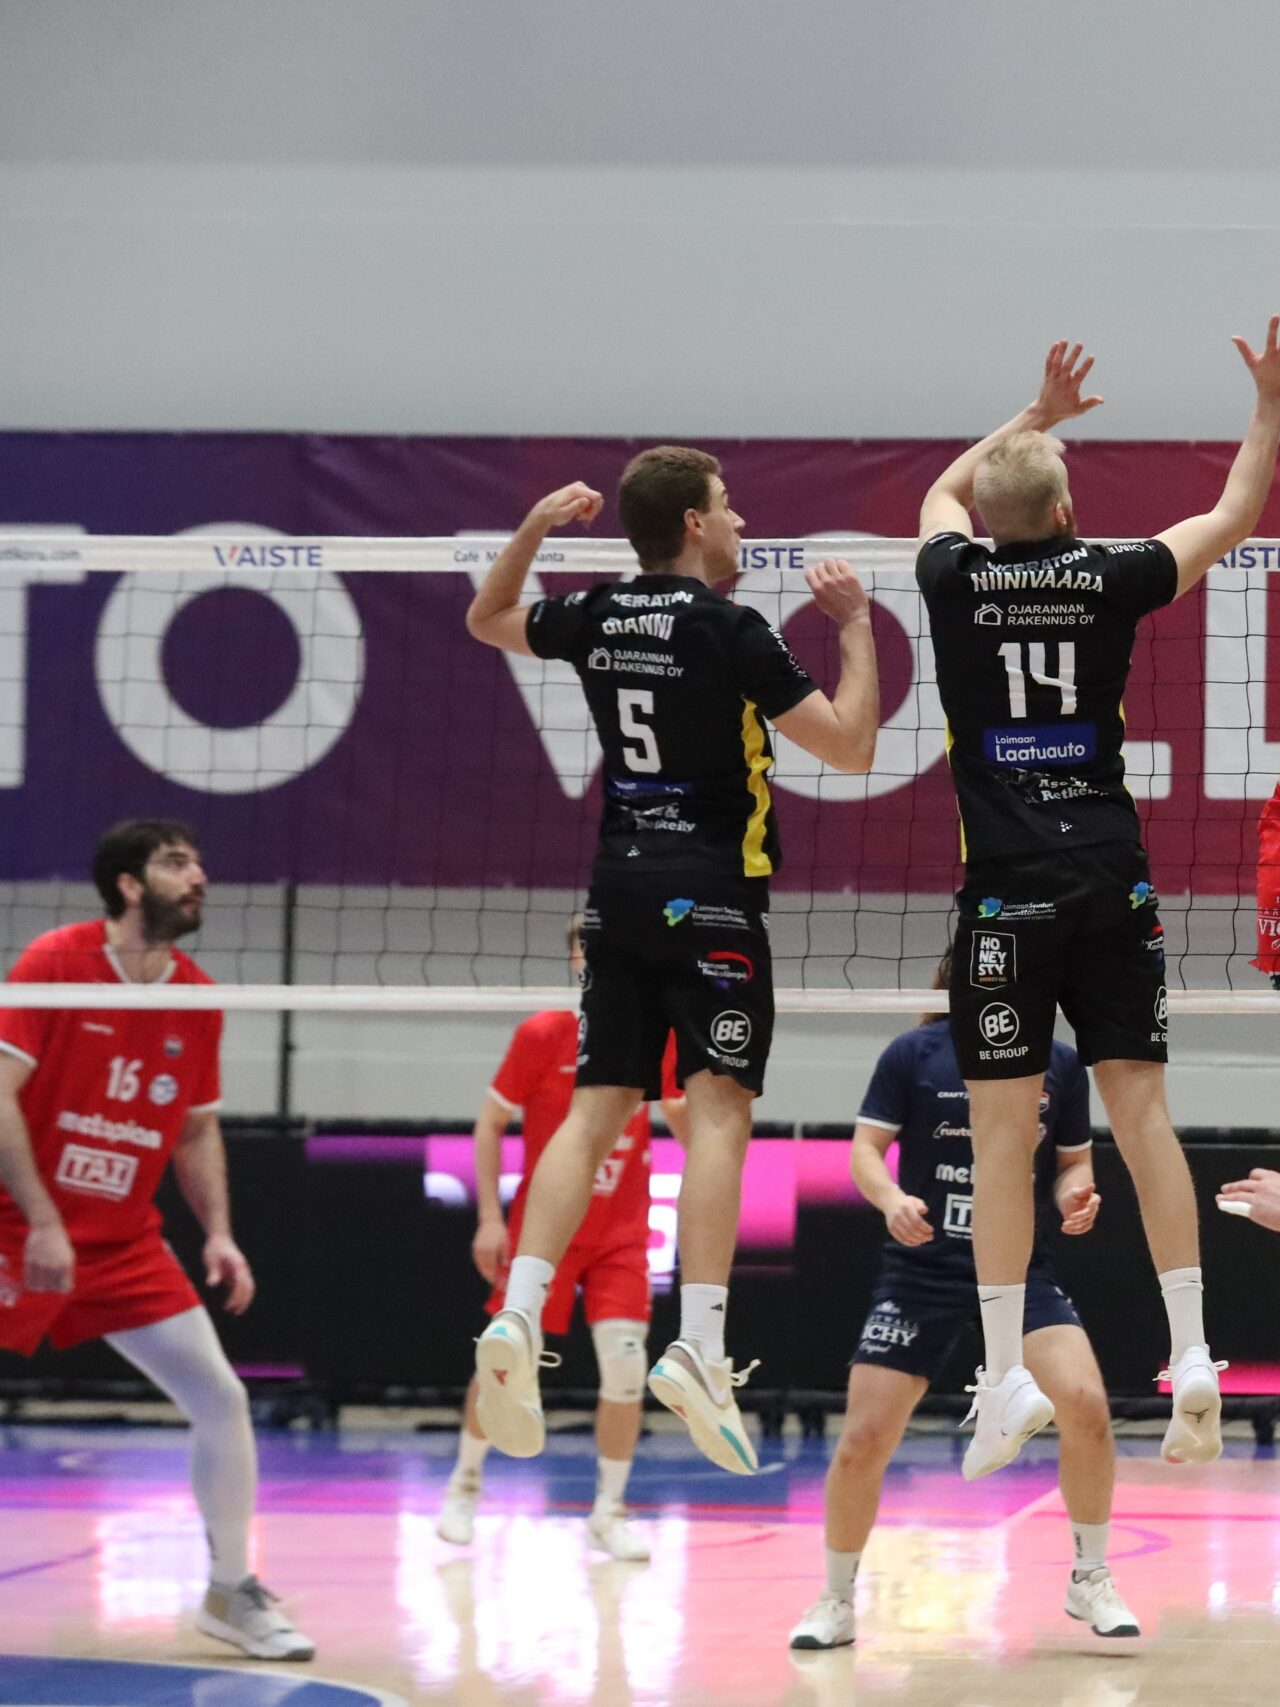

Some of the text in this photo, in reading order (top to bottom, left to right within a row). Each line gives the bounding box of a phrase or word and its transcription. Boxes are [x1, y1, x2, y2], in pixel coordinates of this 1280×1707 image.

[212, 545, 323, 567] VAISTE
[741, 547, 804, 569] ISTE
[970, 569, 1103, 592] NIINIVAARA
[1007, 614, 1095, 625] RAKENNUS OY
[1008, 604, 1084, 614] OJARANNAN
[997, 642, 1077, 718] 14
[617, 688, 662, 774] 5
[995, 735, 1036, 744] Loimaan
[995, 742, 1085, 762] Laatuauto
[980, 936, 1000, 950] HO
[979, 951, 1007, 964] NEY
[978, 963, 1006, 976] STY
[715, 1019, 746, 1042] BE
[985, 1010, 1014, 1038] BE
[721, 1056, 749, 1068] ROUP
[979, 1046, 1029, 1060] BE GROUP
[106, 1055, 143, 1102] 16
[862, 1325, 918, 1347] ICHY
